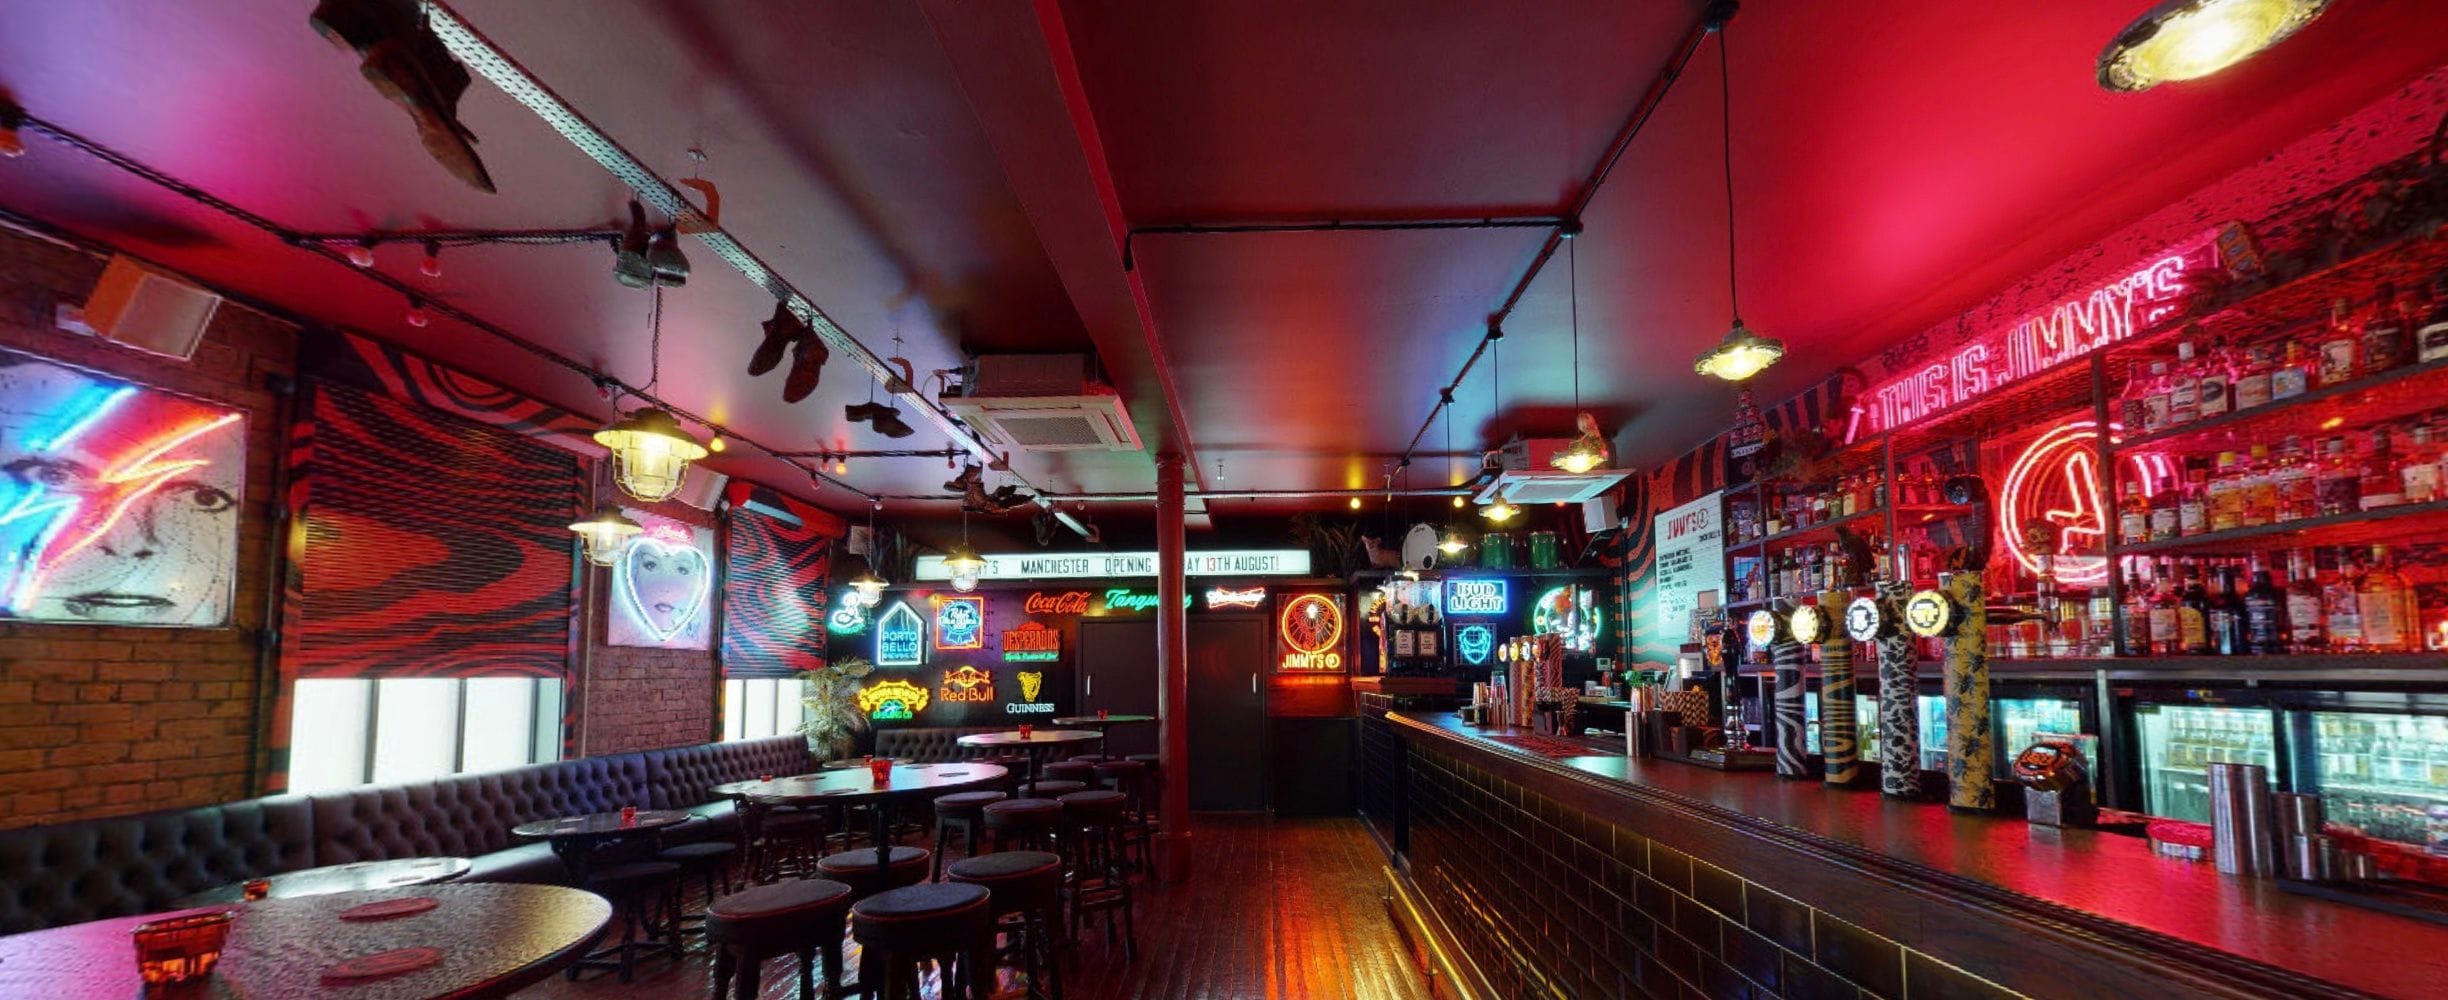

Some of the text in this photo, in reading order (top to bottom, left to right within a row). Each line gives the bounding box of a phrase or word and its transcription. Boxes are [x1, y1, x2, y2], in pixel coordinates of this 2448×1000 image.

[1877, 364, 1949, 430] THIS
[1951, 344, 1989, 403] IS
[1020, 558, 1090, 575] MANCHESTER
[1105, 557, 1152, 573] OPENING
[1206, 556, 1231, 571] 13TH
[1233, 556, 1280, 571] AUGUST!
[1457, 582, 1496, 597] BUD
[1451, 595, 1503, 611] LIGHT
[882, 631, 918, 641] PORTO
[1003, 630, 1058, 650] DESPERADOS
[882, 641, 918, 652] BELLO
[940, 686, 994, 701] Red Bull
[1006, 703, 1055, 713] GUINNESS
